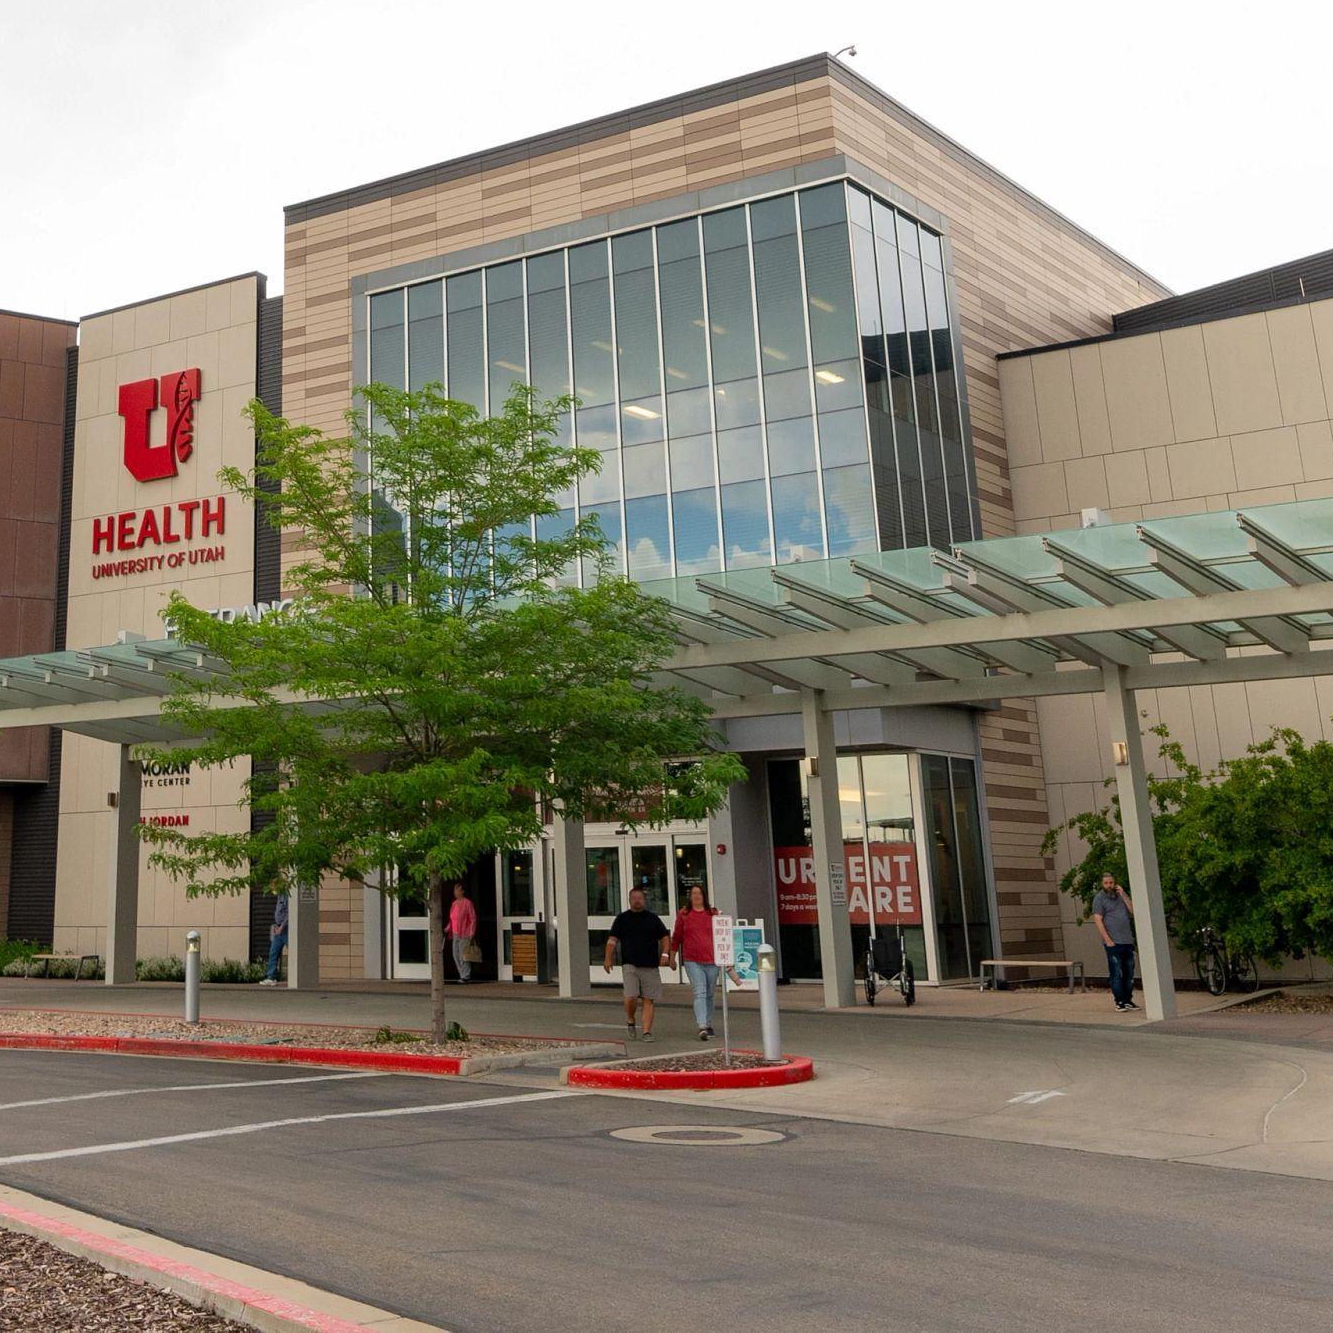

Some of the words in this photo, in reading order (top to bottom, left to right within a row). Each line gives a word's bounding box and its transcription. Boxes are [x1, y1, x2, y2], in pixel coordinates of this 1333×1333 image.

[92, 496, 226, 555] HEALTH
[92, 554, 165, 580] UNIVERSITY
[168, 550, 186, 568] OF
[188, 545, 225, 565] UTAH
[141, 779, 154, 788] YE
[157, 777, 191, 788] CENTER
[150, 815, 189, 827] JORDAN
[778, 855, 911, 884] URENT
[847, 885, 915, 913] ARE
